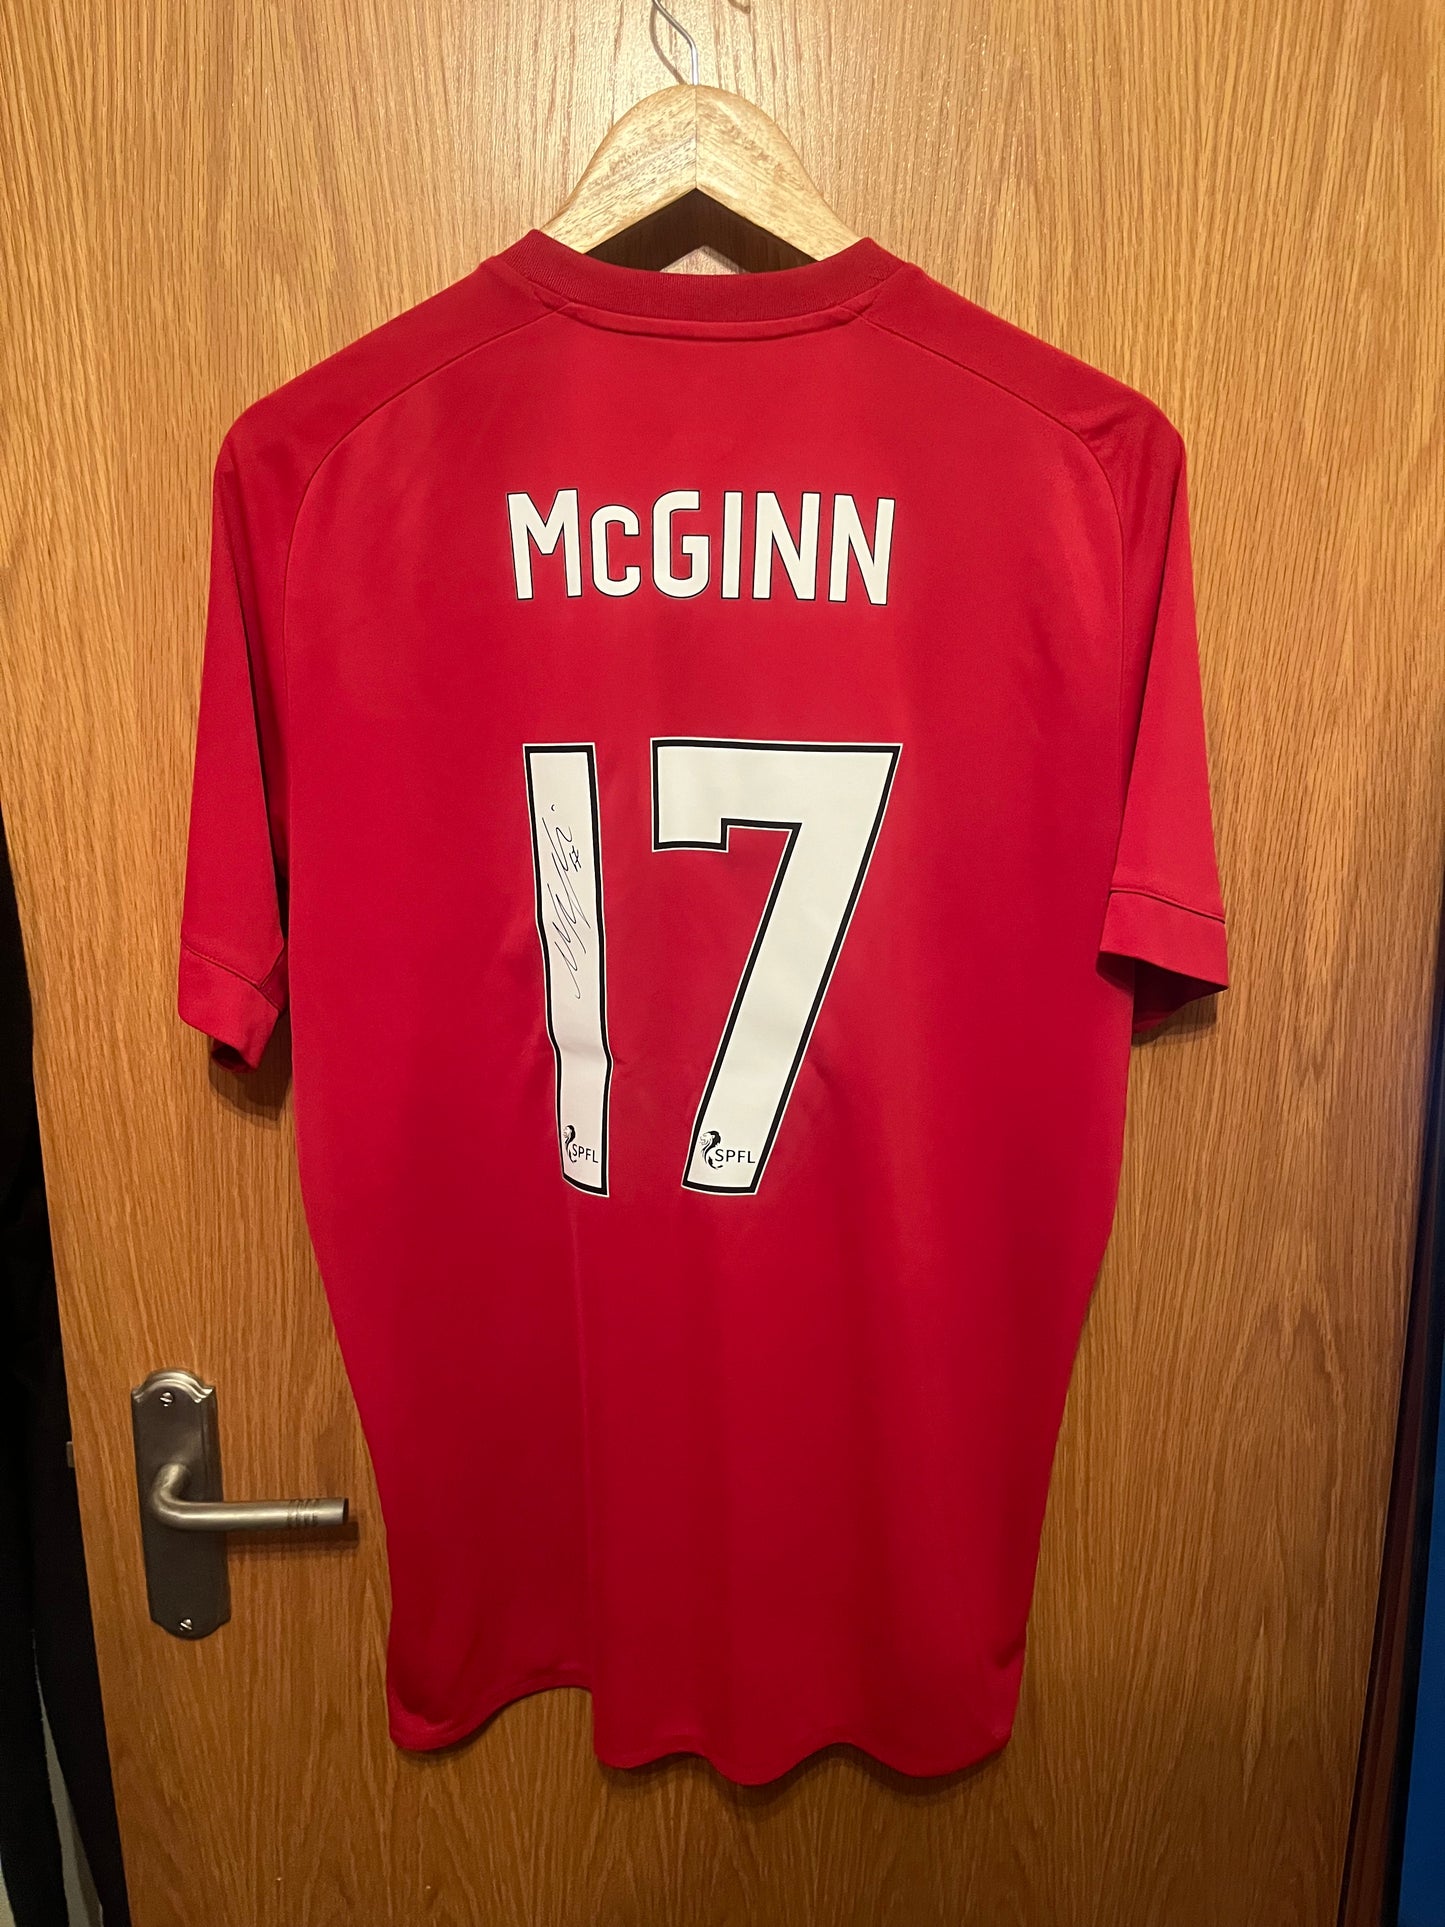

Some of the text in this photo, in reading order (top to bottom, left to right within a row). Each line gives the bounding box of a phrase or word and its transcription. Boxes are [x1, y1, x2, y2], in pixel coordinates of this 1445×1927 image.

[506, 488, 896, 606] McGINN
[523, 737, 902, 1197] 17
[572, 1143, 599, 1164] SPFL
[714, 1148, 756, 1164] SPFL
